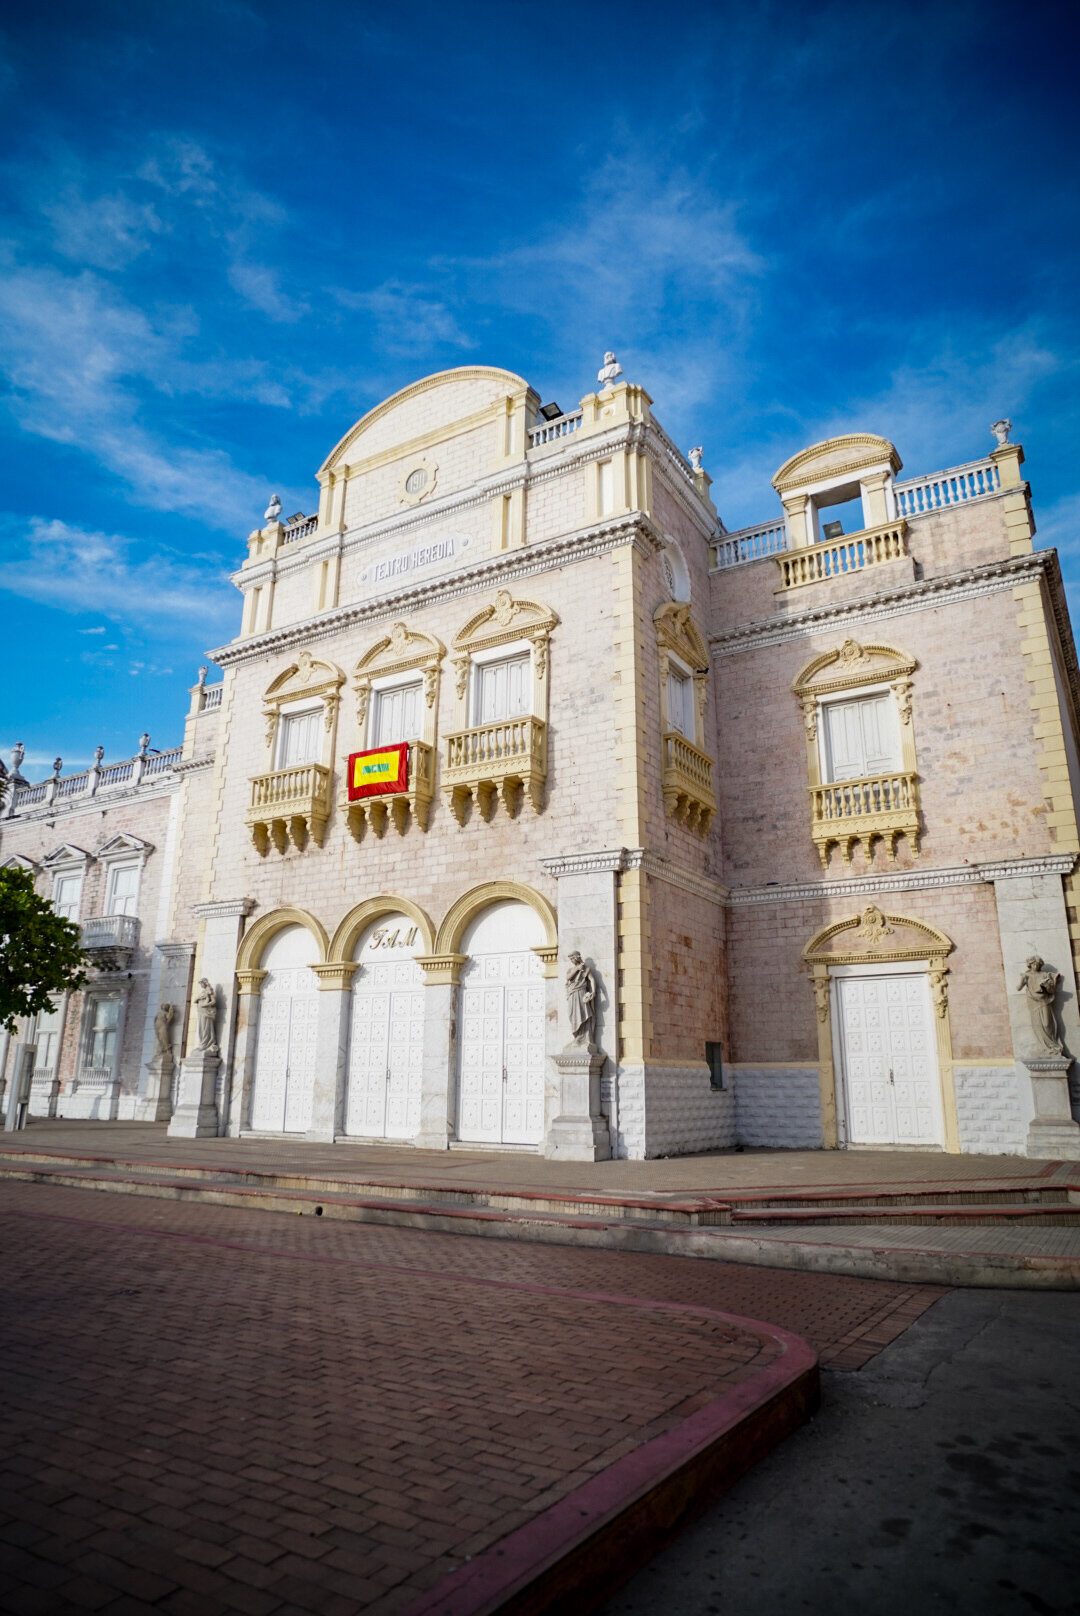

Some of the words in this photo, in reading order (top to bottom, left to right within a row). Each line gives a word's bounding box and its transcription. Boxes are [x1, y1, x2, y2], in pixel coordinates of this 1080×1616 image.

[409, 472, 425, 492] 1911
[373, 554, 410, 582] TEATRO
[412, 539, 455, 570] HEREDIA
